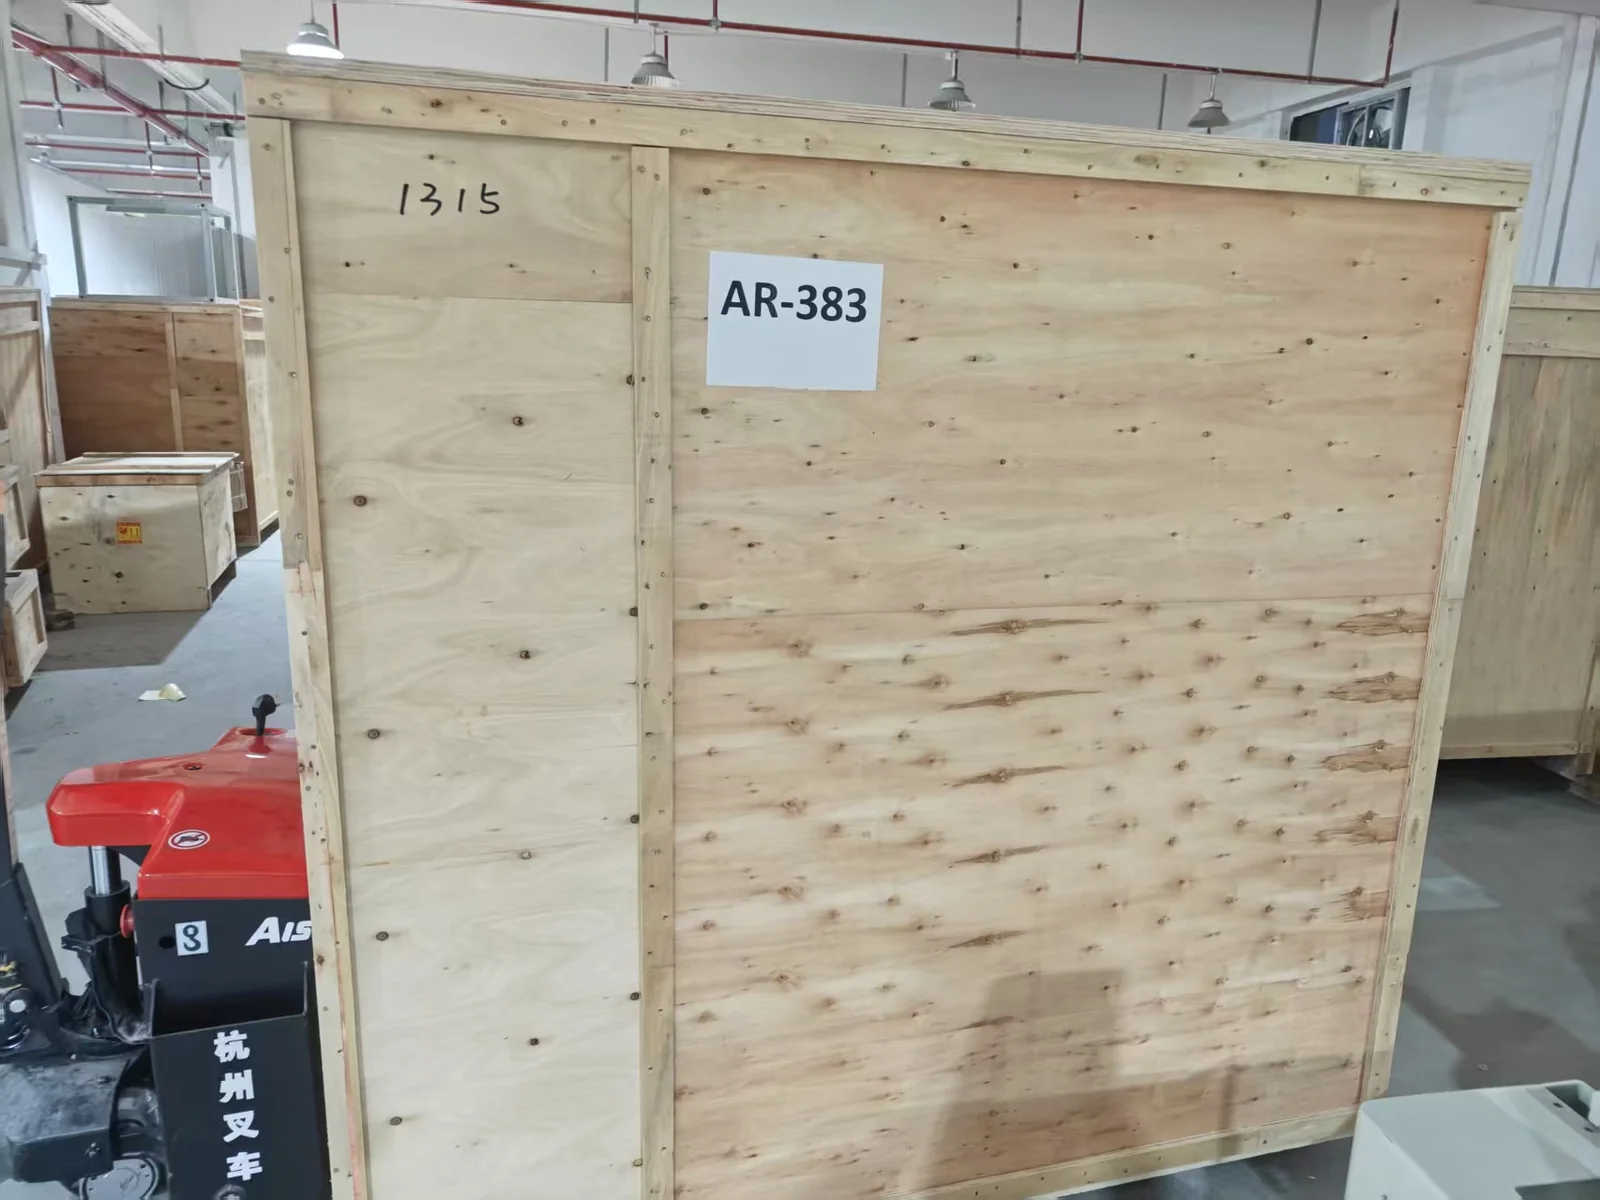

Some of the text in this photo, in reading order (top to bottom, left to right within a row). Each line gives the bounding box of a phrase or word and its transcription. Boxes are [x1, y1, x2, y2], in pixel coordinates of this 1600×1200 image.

[399, 182, 501, 216] 1315
[720, 280, 867, 323] AR-383
[213, 1029, 263, 1181] 杭州叉车
